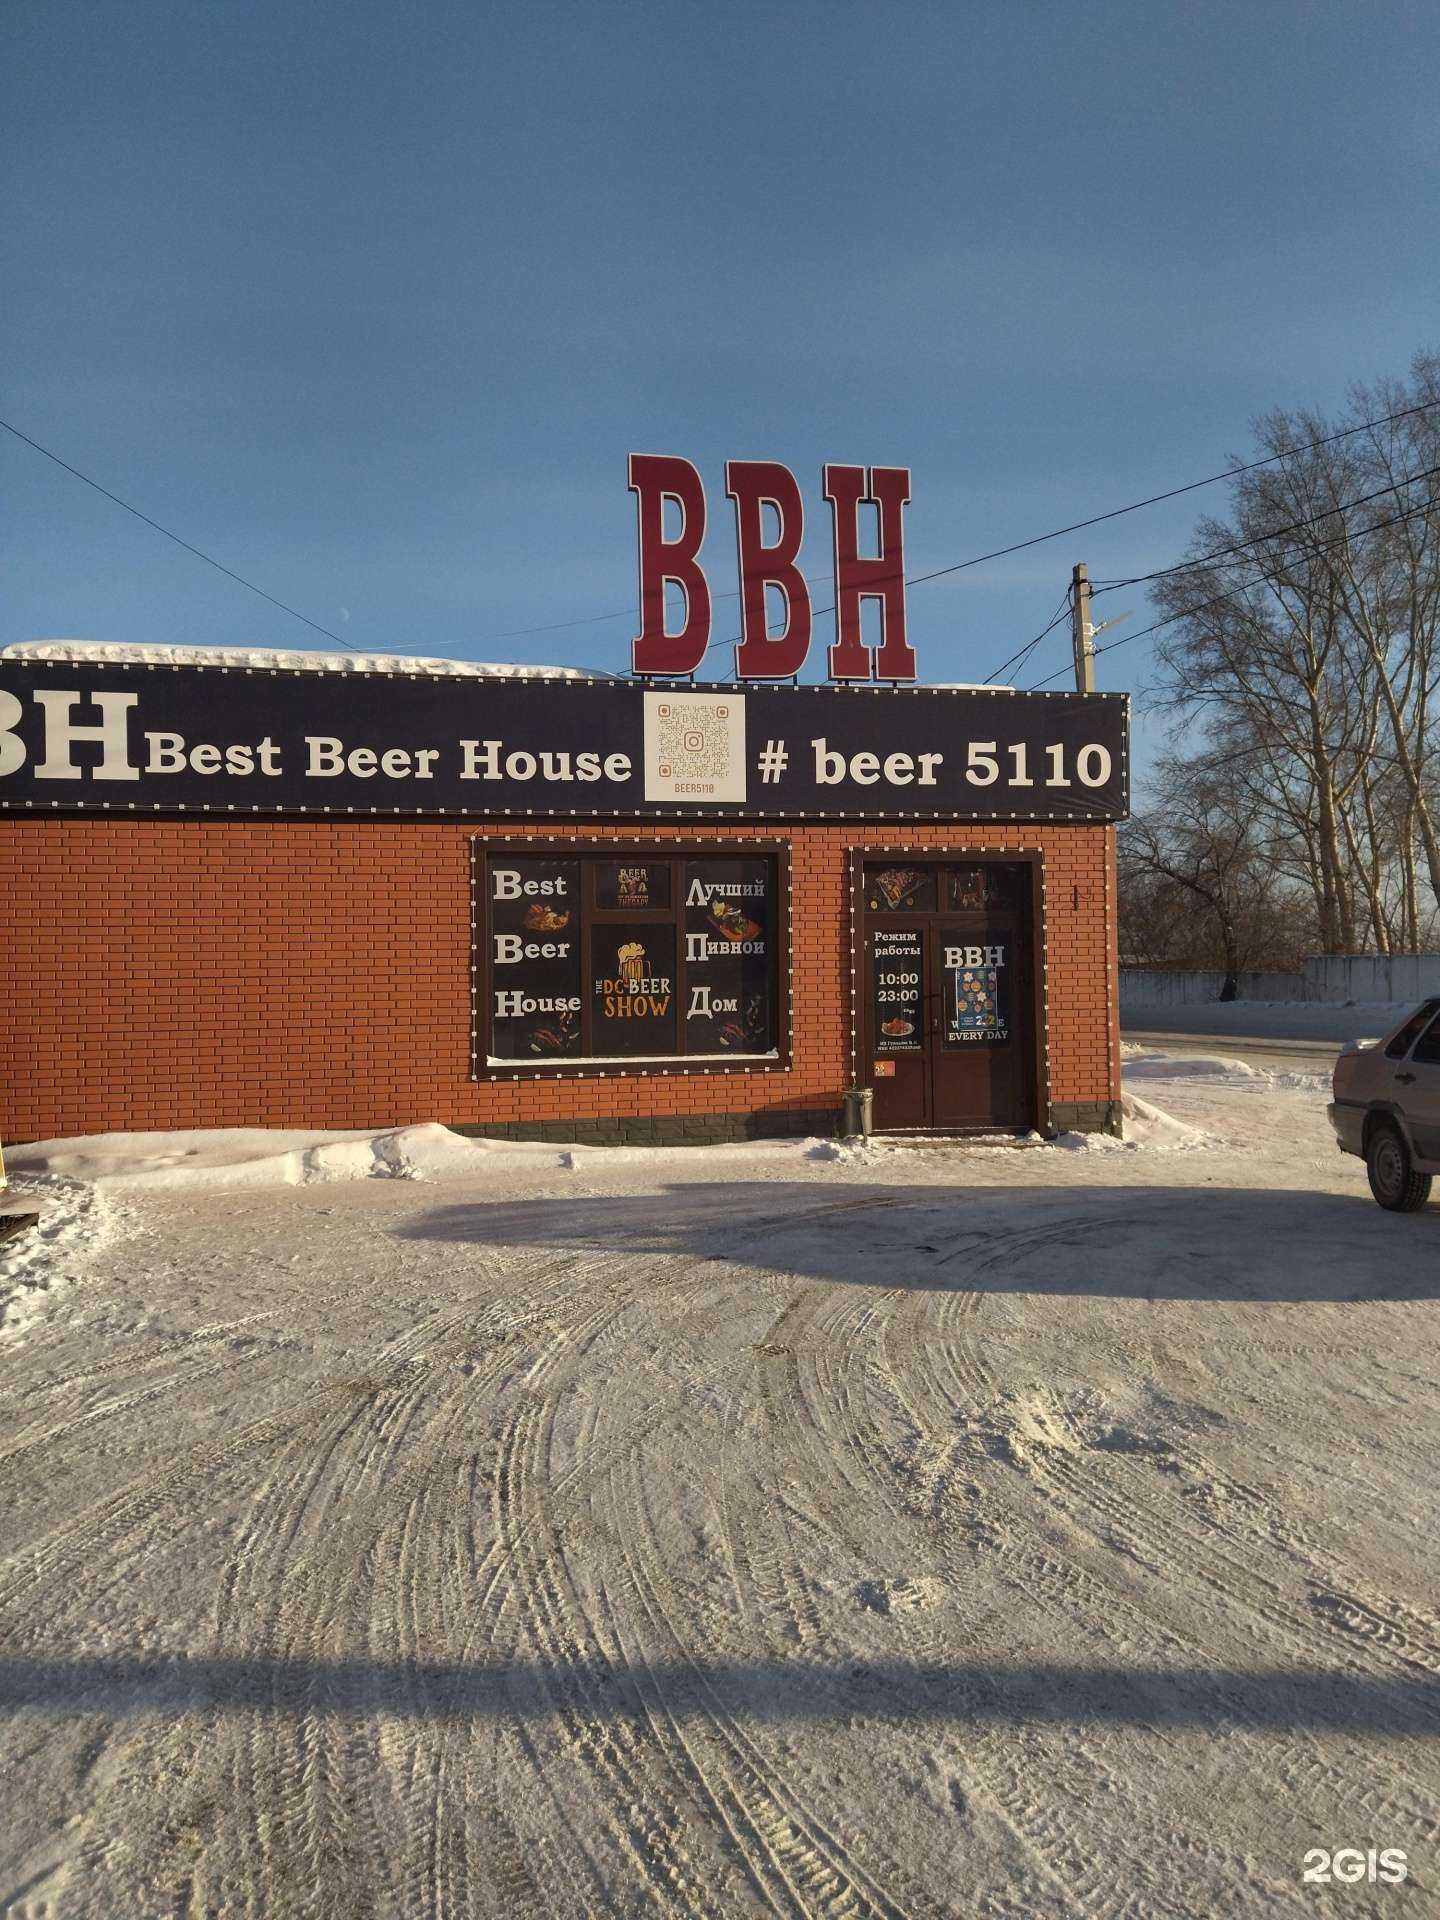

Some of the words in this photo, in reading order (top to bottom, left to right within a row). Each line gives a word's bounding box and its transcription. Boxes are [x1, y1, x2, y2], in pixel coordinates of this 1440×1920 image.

[628, 453, 917, 681] BBH
[144, 731, 282, 776] Best
[305, 736, 440, 778] Beer
[459, 740, 632, 781] House
[758, 740, 788, 783] #
[811, 738, 943, 785] beer
[965, 742, 1112, 787] 5110
[492, 870, 567, 900] Best
[685, 878, 765, 906] Лучший
[874, 931, 917, 941] Режим
[493, 934, 570, 964] Beer
[874, 945, 921, 958] работы
[944, 946, 1005, 968] BBH
[629, 978, 671, 994] BEER
[879, 973, 919, 985] 10:00
[494, 990, 582, 1017] House
[604, 995, 671, 1017] SHOW
[686, 986, 738, 1020] Дом
[878, 989, 919, 1002] 23:00
[948, 1031, 984, 1041] EVERY
[987, 1030, 1009, 1040] DAY
